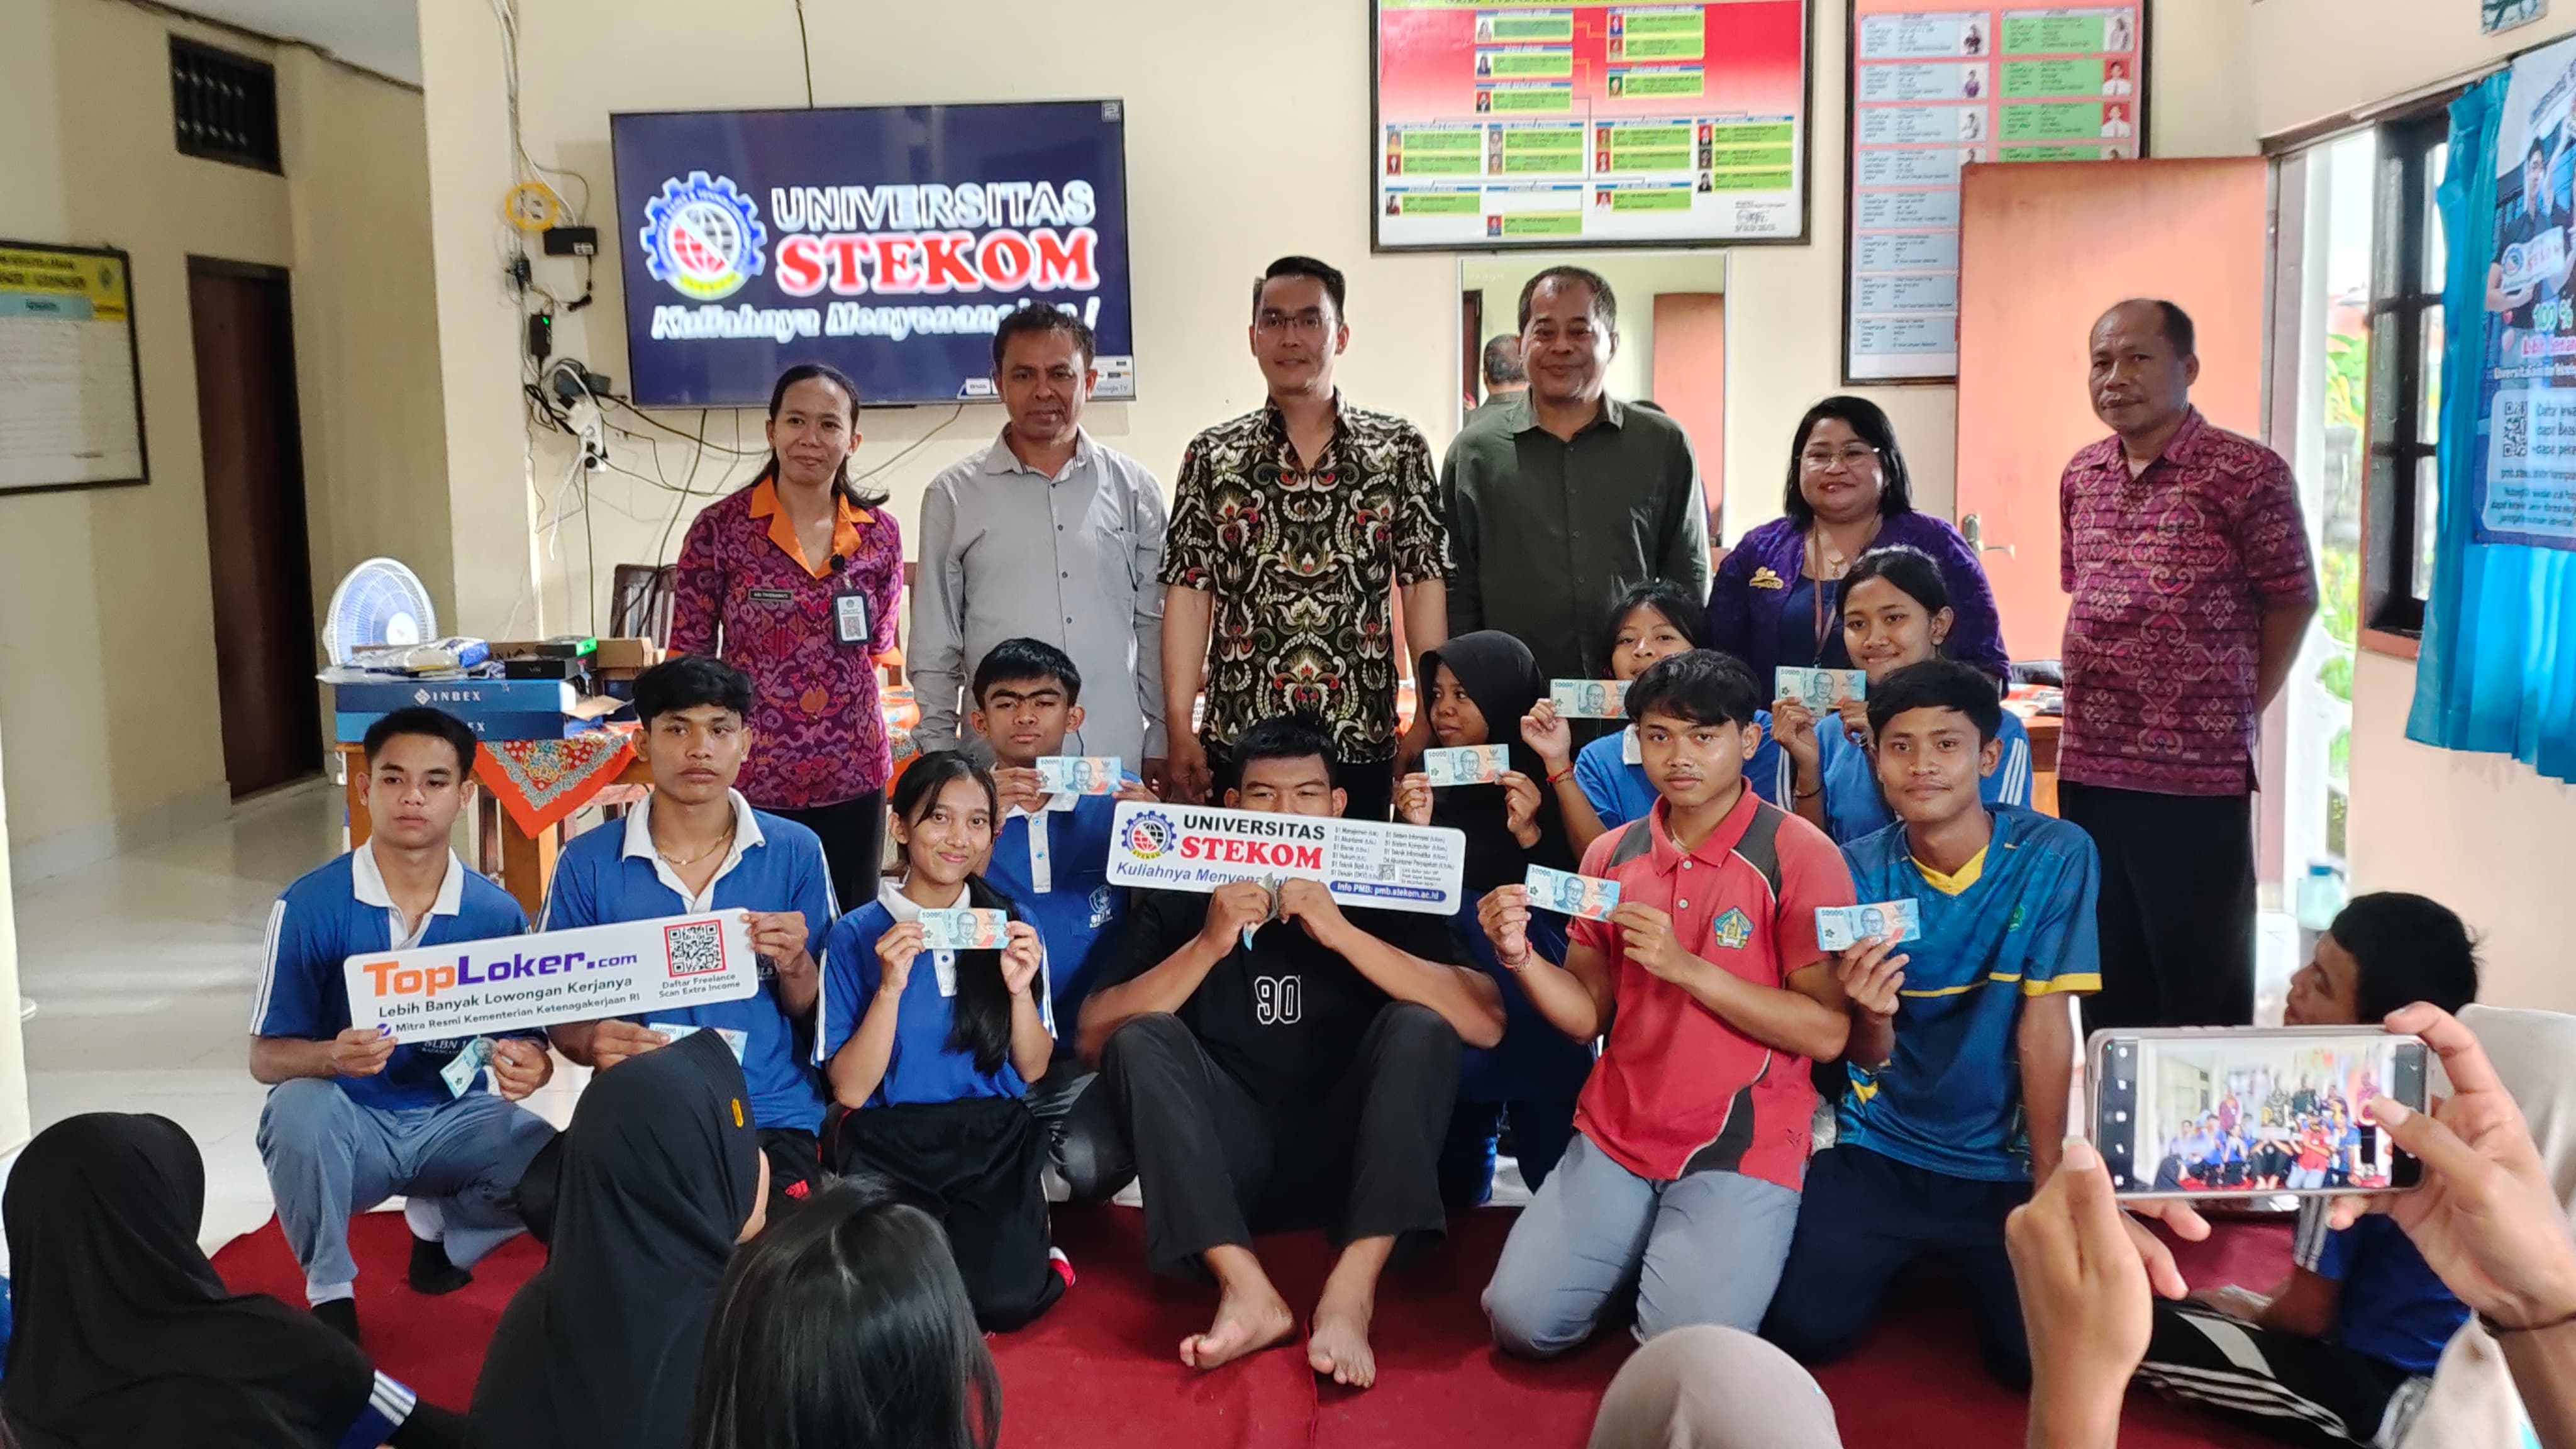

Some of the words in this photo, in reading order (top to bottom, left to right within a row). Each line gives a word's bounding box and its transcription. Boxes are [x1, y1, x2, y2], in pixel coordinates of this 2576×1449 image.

[771, 180, 1096, 232] UNIVERSITAS
[776, 228, 1100, 296] STEKOM
[651, 303, 821, 343] Kuliahnya
[826, 297, 1078, 342] Menyenan
[433, 691, 481, 701] INDEX
[1184, 814, 1325, 840] UNIVERSITAS
[1180, 836, 1323, 870] STEKOM
[1116, 862, 1191, 883] Kuliahnya
[1337, 883, 1352, 892] Info
[1353, 884, 1373, 894] PMB:
[1374, 887, 1439, 900] pmb.stekom.ac.id
[363, 951, 638, 997] TopLoker.com
[658, 990, 680, 999] Scan
[682, 985, 706, 995] Extra
[709, 981, 741, 992] Income
[662, 979, 691, 989] Daftar
[693, 974, 736, 985] Freelance
[379, 1002, 420, 1018] Lebih
[425, 996, 480, 1013] Banyak
[485, 986, 564, 1006] Lowongan
[568, 976, 633, 996] Kerjanya
[396, 1019, 425, 1033] Mitra
[428, 1015, 462, 1029] Resmi
[463, 1007, 533, 1025] Kementerian
[536, 996, 627, 1016] Ketenagakerjaan
[629, 994, 640, 1003] RI
[1254, 975, 1301, 1024] 90
